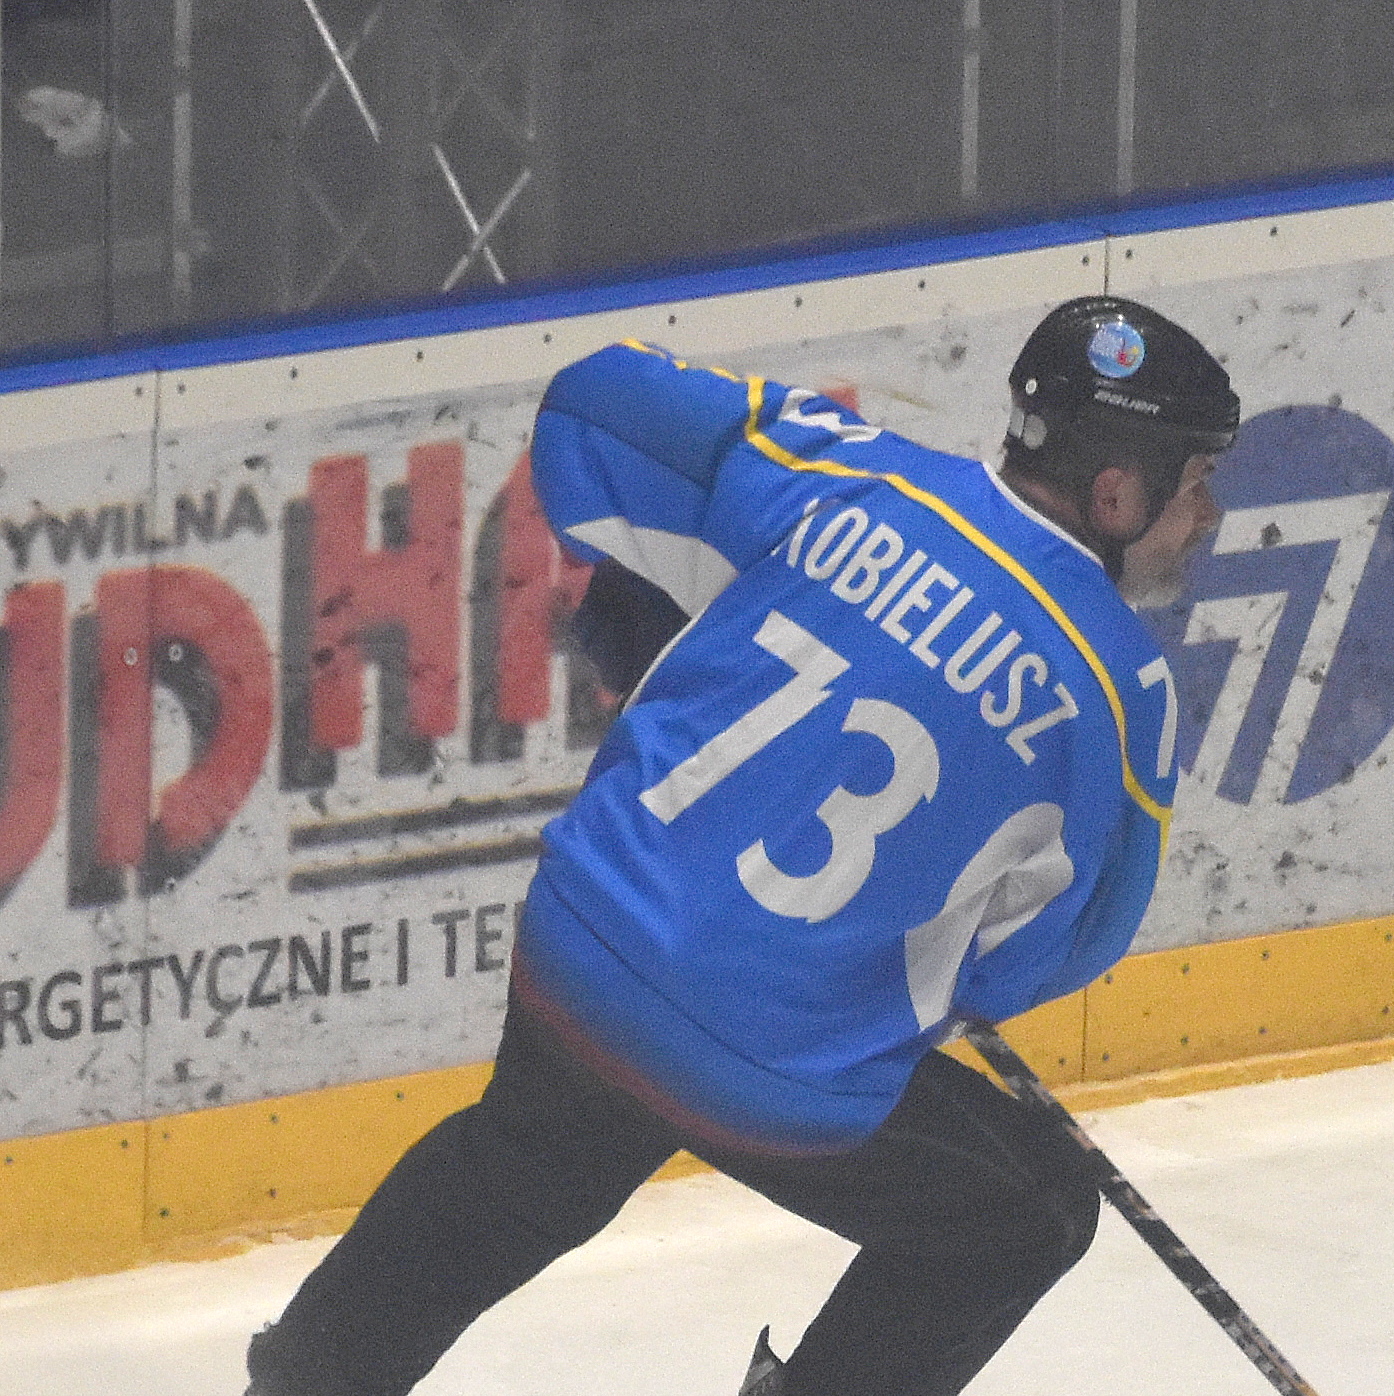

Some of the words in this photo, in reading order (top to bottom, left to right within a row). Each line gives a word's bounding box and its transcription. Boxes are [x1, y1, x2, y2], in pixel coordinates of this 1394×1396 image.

[638, 609, 941, 923] 73
[397, 918, 410, 986] I
[432, 903, 508, 978] TE
